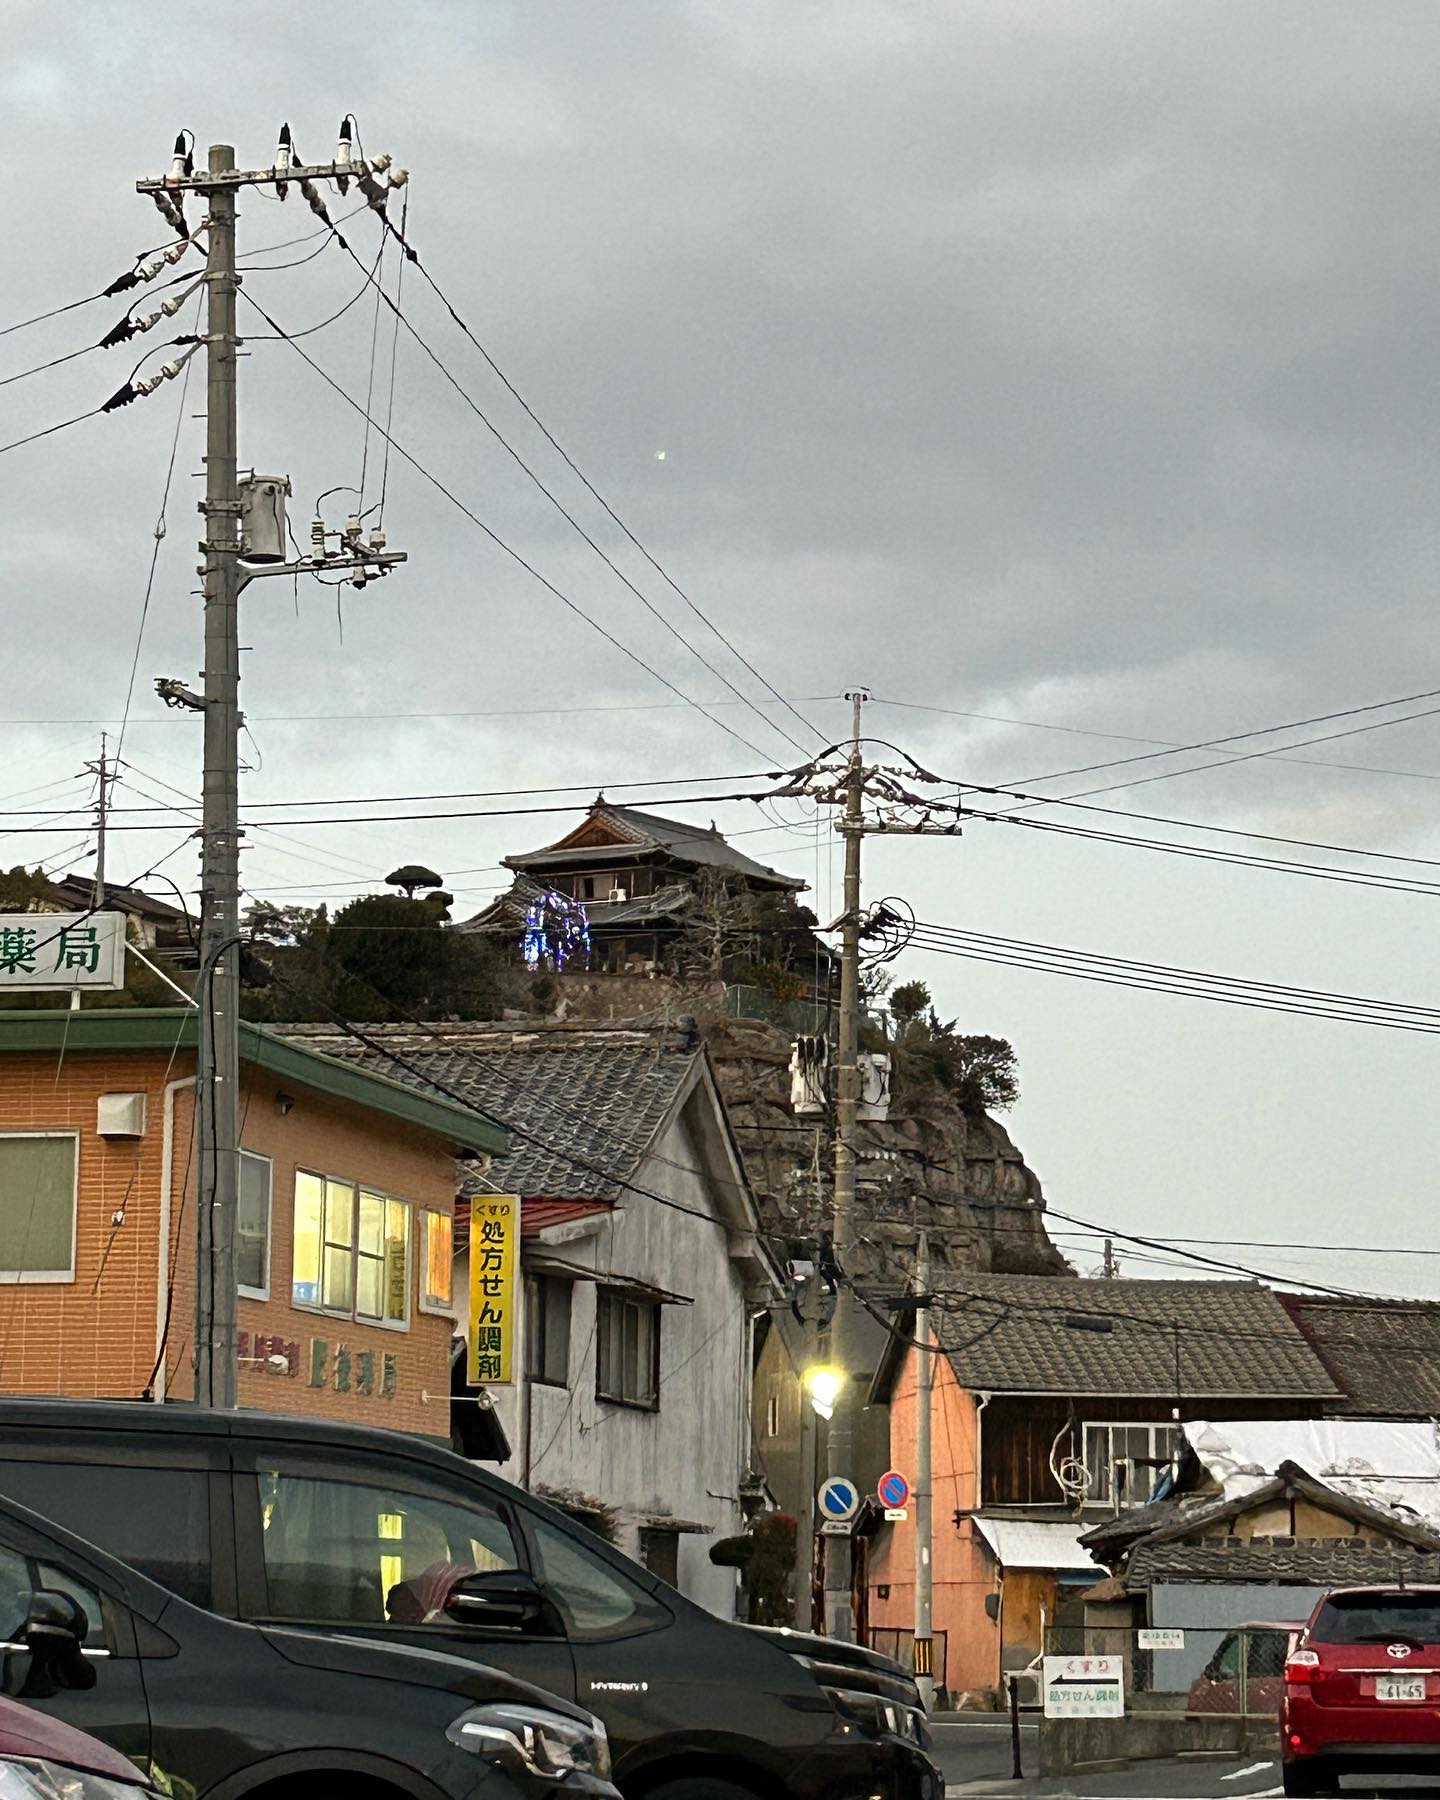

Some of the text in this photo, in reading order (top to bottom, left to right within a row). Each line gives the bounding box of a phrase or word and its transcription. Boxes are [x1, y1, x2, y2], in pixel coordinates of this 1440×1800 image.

[475, 1204, 510, 1216] くすり
[478, 1220, 505, 1380] 処方せん調剤
